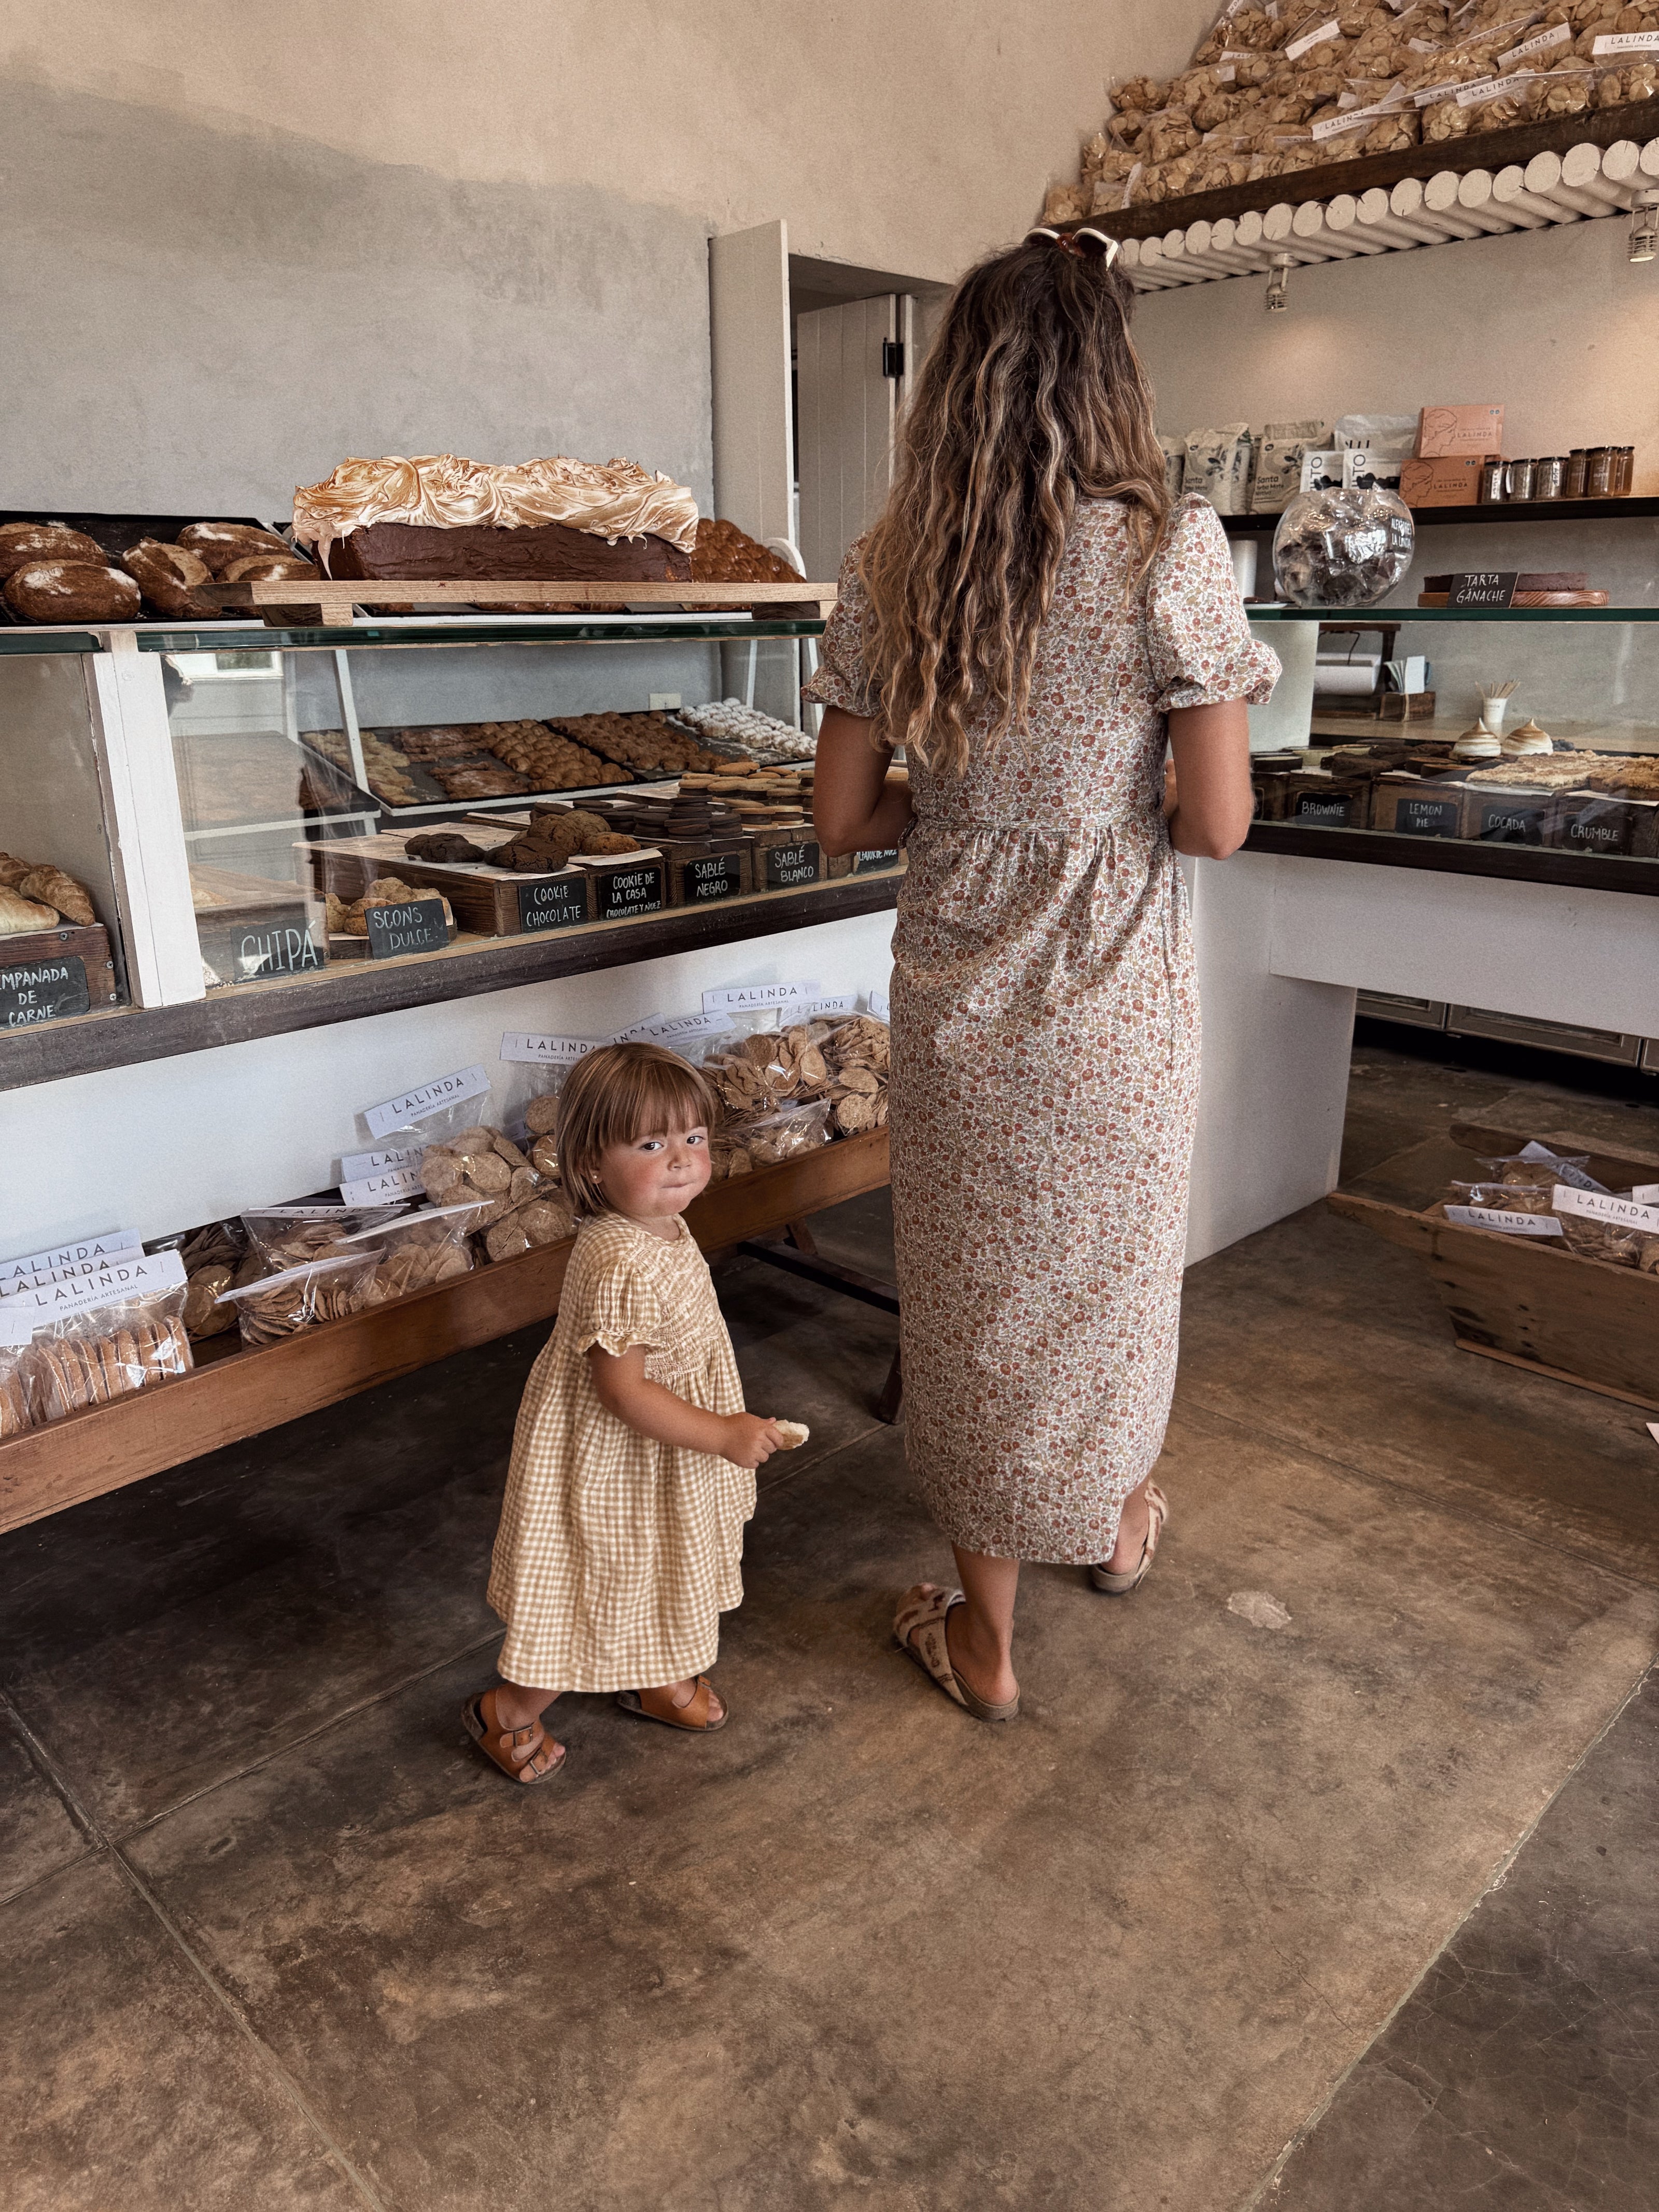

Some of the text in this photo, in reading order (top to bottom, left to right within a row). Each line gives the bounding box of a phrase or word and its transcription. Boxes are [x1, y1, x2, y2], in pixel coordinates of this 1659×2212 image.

[1511, 32, 1555, 58] LALINDA
[1611, 34, 1659, 45] LALINDA
[1430, 83, 1477, 98] LALINDA
[1472, 78, 1519, 96] LALINDA
[1325, 112, 1363, 130] LALIN
[1465, 574, 1499, 587] TARTA
[1410, 803, 1442, 816] LEMON
[1488, 814, 1526, 833] COCADA
[1570, 824, 1619, 841] CRUMBLE
[775, 844, 805, 869] SABLÉ
[695, 856, 726, 879] SABLÉ
[781, 866, 814, 882] BLANCO
[612, 872, 655, 890] COOKIE DE
[697, 880, 728, 897] NEGRO
[612, 887, 647, 904] LA CASA
[373, 906, 423, 929] SCONS
[526, 905, 581, 927] CHOCOLATE
[606, 900, 661, 919] CHOCOLATE Y NUEZ
[241, 920, 318, 974] CHIPÁ
[390, 928, 434, 950] DULCE
[18, 990, 38, 1005] DE
[727, 987, 798, 1003] LALINDA
[8, 1005, 56, 1027] CARNE
[798, 1001, 843, 1013] LLINDA
[650, 1017, 711, 1036] LALINDA
[527, 1038, 596, 1053] LALIND
[392, 1077, 464, 1114] LALINDA
[371, 1146, 429, 1166] LALIN
[367, 1171, 418, 1192] LALIN
[1577, 1194, 1650, 1220] LALINDA
[1468, 1210, 1536, 1226] LALINDA
[0, 1244, 105, 1281] ALINDA
[0, 1260, 110, 1297] LALINDA
[35, 1265, 148, 1306] LALINDA
[60, 1284, 138, 1312] PANADERÍA ARTESANAL
